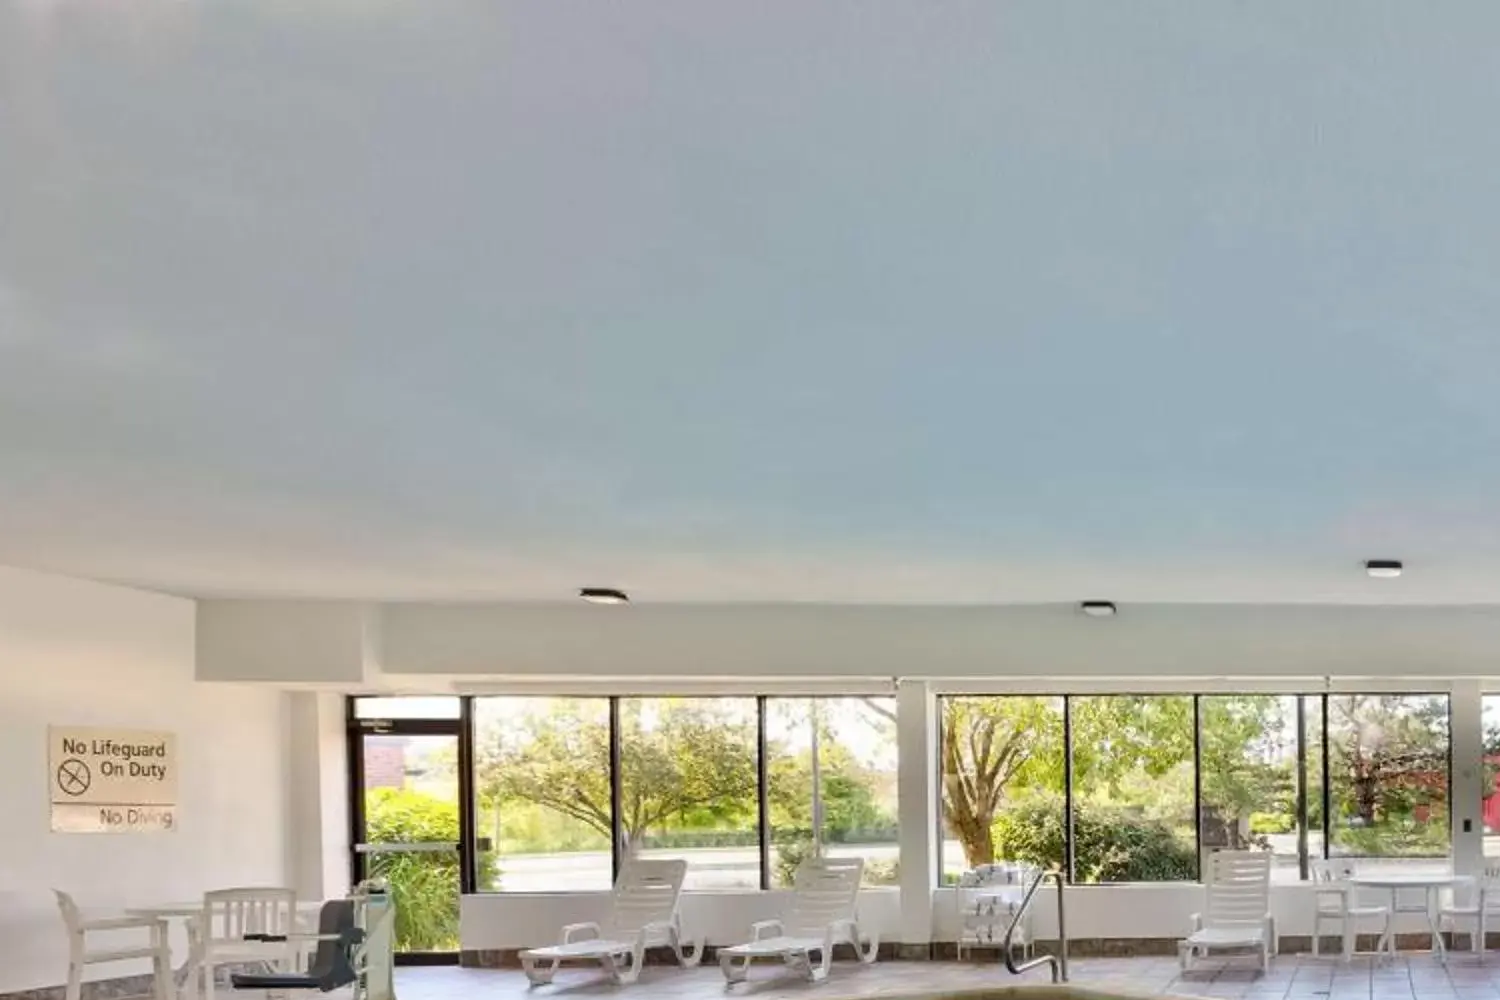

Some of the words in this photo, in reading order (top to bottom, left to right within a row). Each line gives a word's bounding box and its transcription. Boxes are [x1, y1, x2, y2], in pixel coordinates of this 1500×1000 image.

[63, 738, 87, 755] No
[92, 740, 165, 760] Lifeguard
[101, 761, 124, 776] On
[128, 761, 167, 781] Duty
[101, 808, 122, 825] No
[127, 809, 173, 829] Divg
